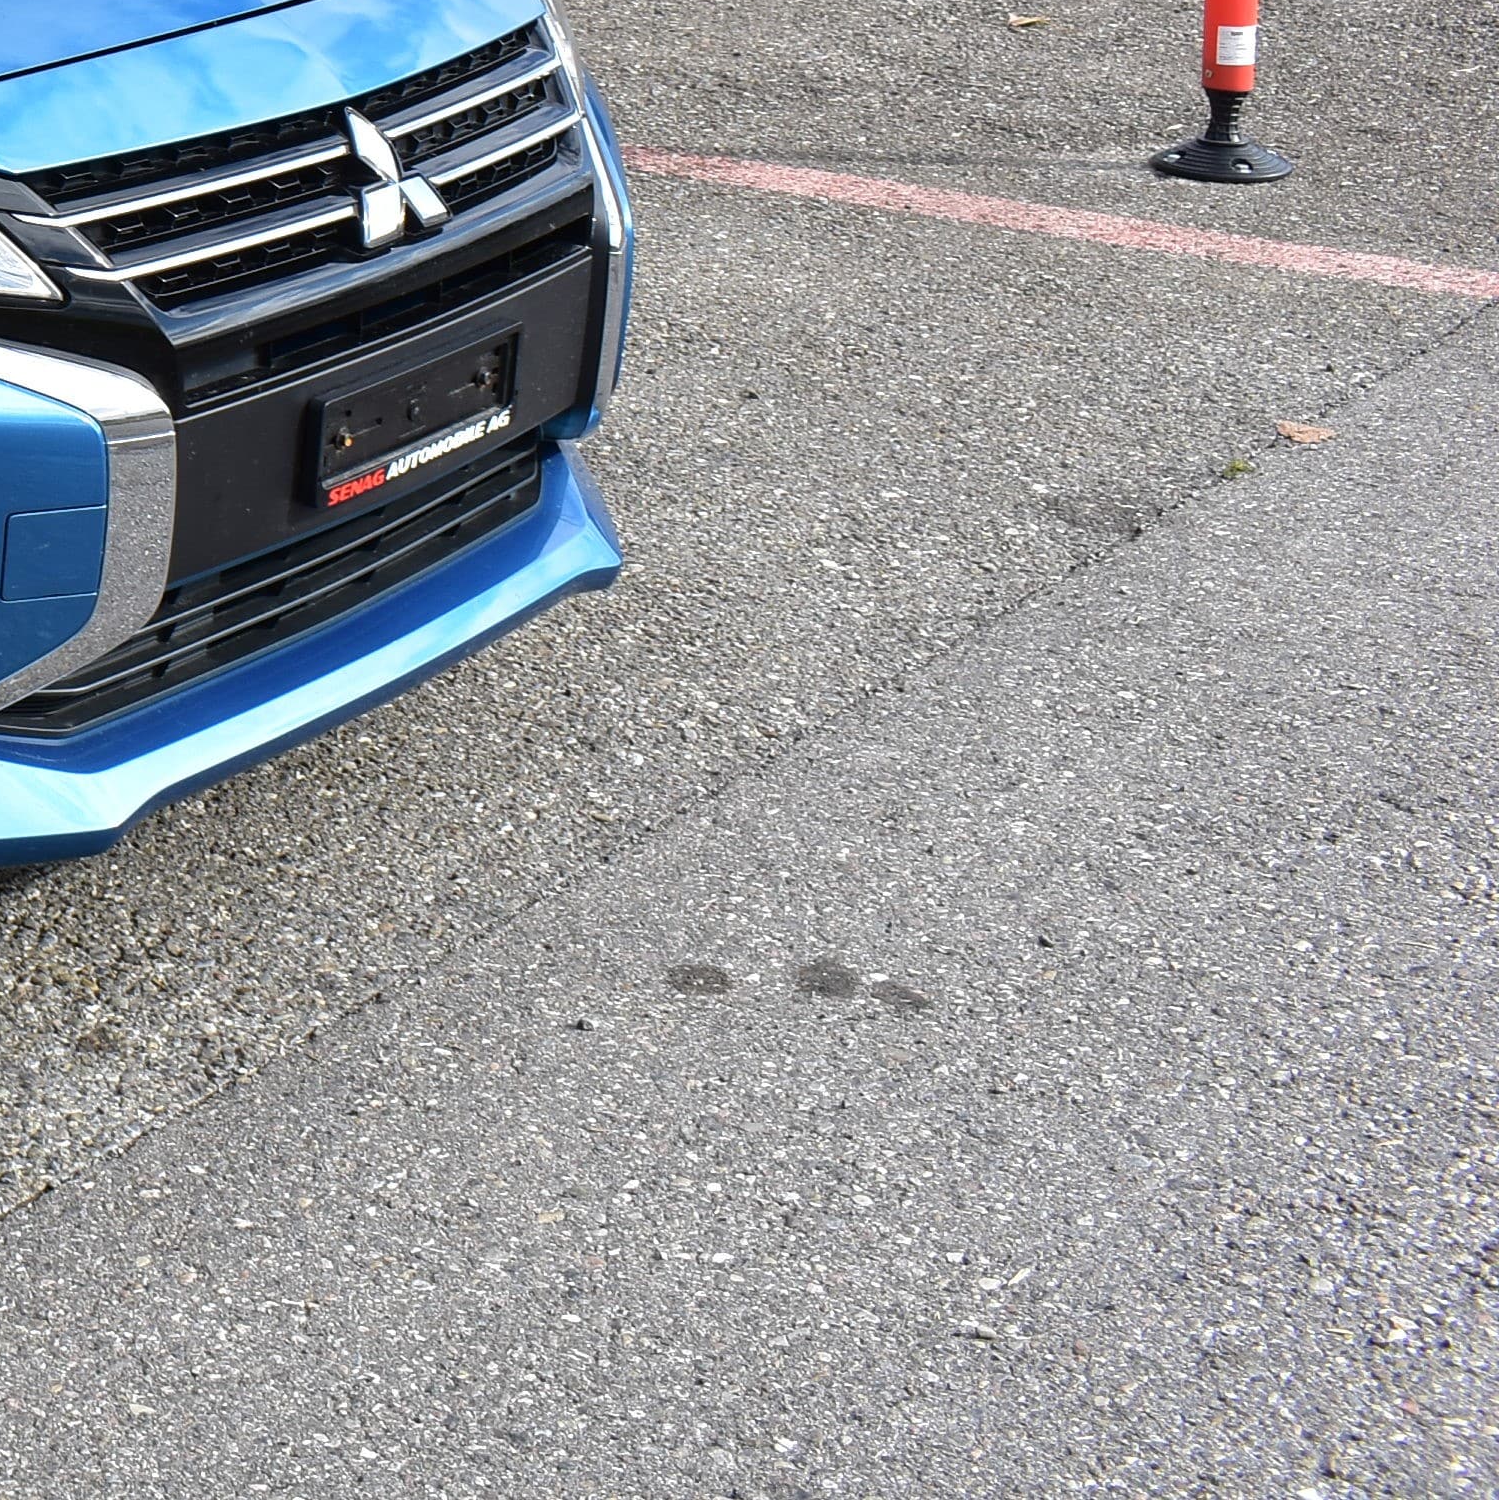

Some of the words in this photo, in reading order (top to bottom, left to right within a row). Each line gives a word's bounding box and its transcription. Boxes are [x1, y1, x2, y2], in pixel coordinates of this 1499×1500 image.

[327, 457, 386, 507] SENAG
[386, 420, 487, 481] AUTOMOBILE
[486, 408, 512, 434] AG
